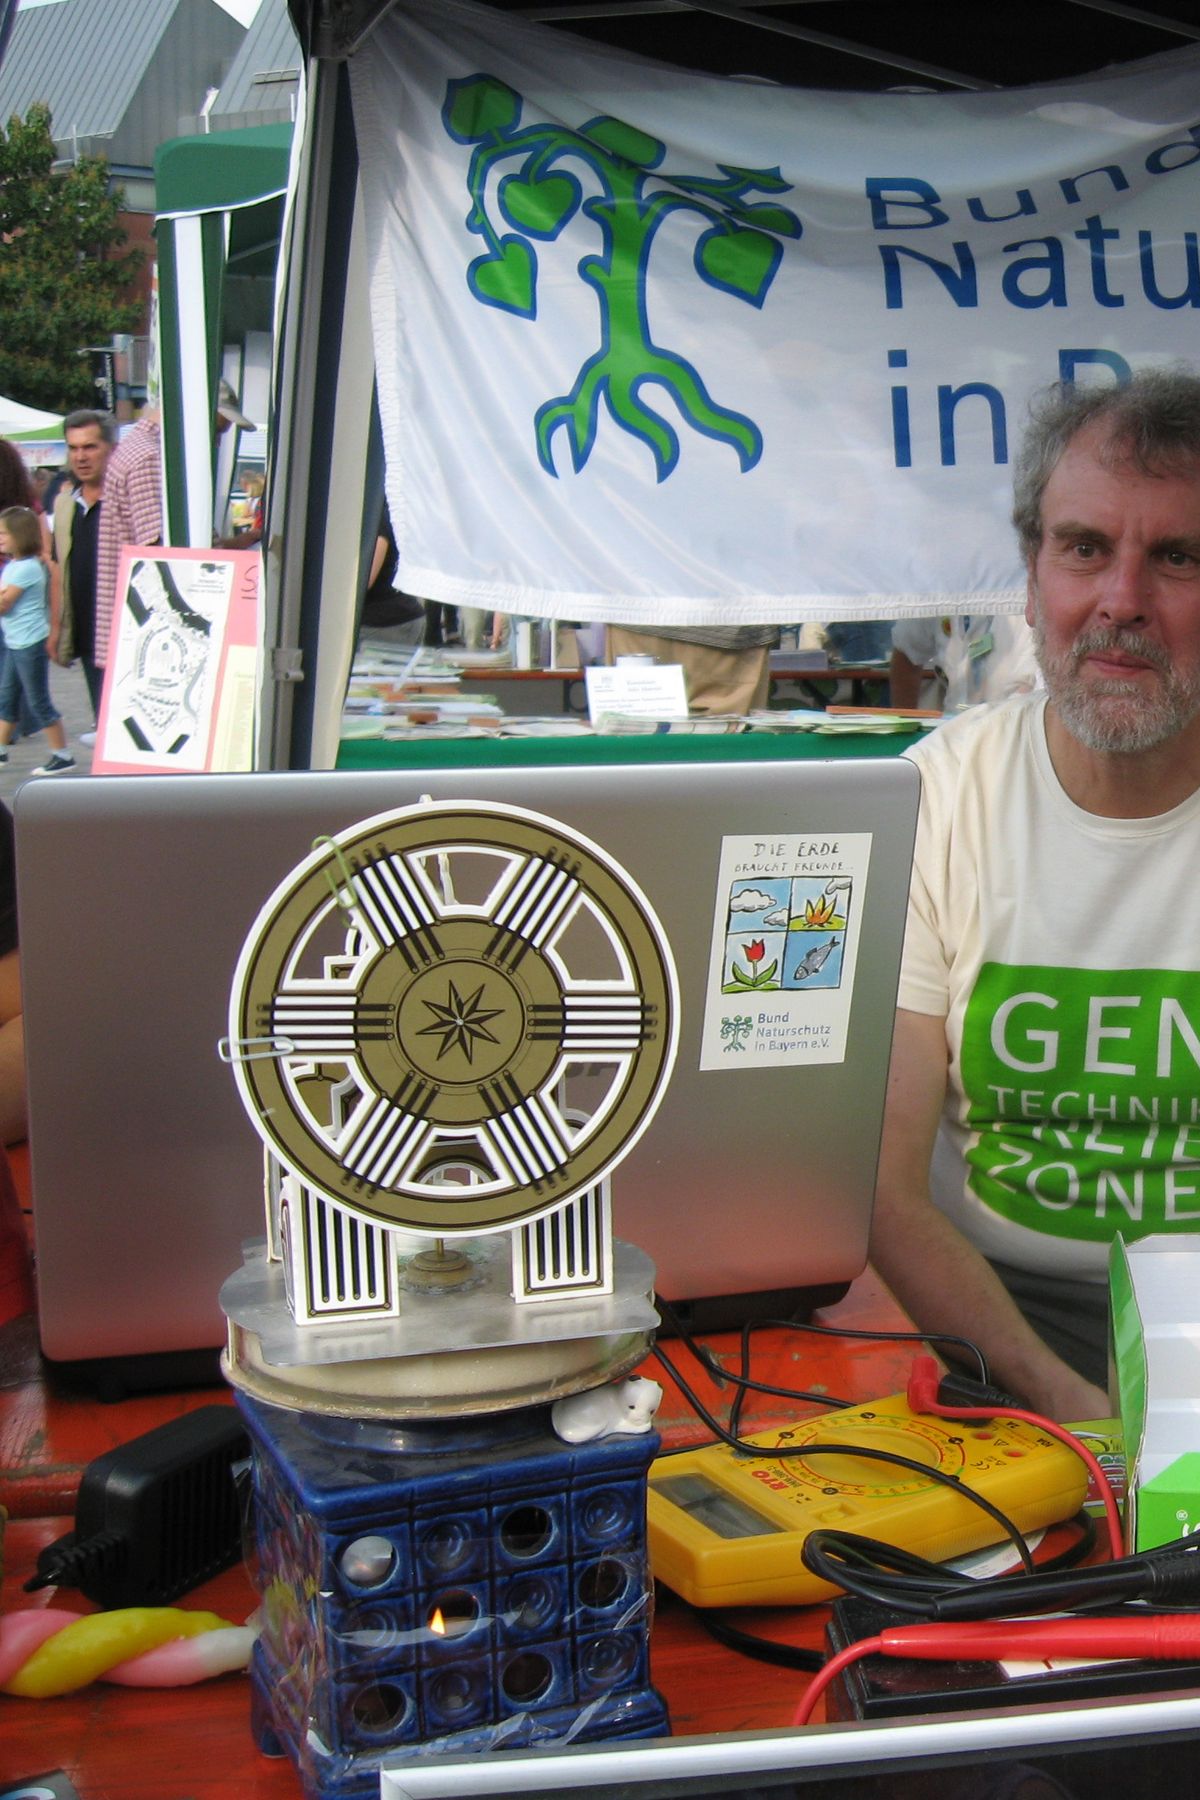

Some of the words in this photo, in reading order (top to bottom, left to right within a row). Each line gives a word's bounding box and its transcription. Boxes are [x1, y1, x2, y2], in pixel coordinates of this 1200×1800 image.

[887, 348, 1009, 468] in
[753, 842, 786, 858] DIE
[797, 842, 841, 857] ERDE
[734, 862, 789, 873] BRAUCHT
[757, 1012, 789, 1024] Bund
[756, 1023, 832, 1038] Naturschutz
[755, 1041, 766, 1052] in
[768, 1039, 809, 1054] Bayern
[810, 1037, 830, 1049] e.V.
[751, 1468, 791, 1493] RTO
